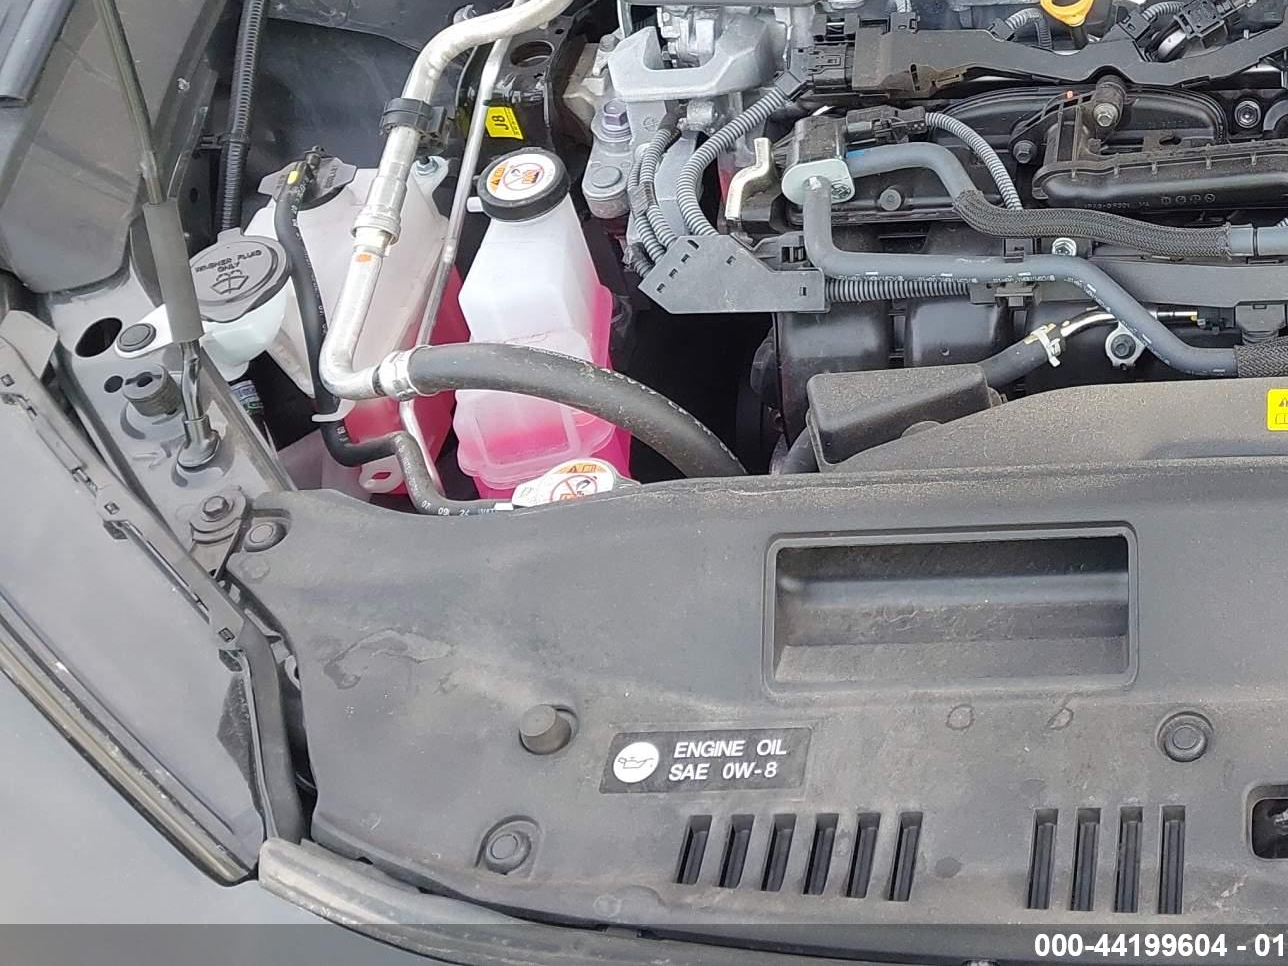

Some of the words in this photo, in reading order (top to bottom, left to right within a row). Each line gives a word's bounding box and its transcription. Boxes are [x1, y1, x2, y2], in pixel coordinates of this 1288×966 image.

[491, 114, 509, 131] J8
[216, 259, 241, 273] ONLY
[673, 740, 746, 758] ENGINE
[756, 738, 788, 756] OIL
[668, 763, 710, 781] SAE
[722, 761, 778, 780] 0W-8
